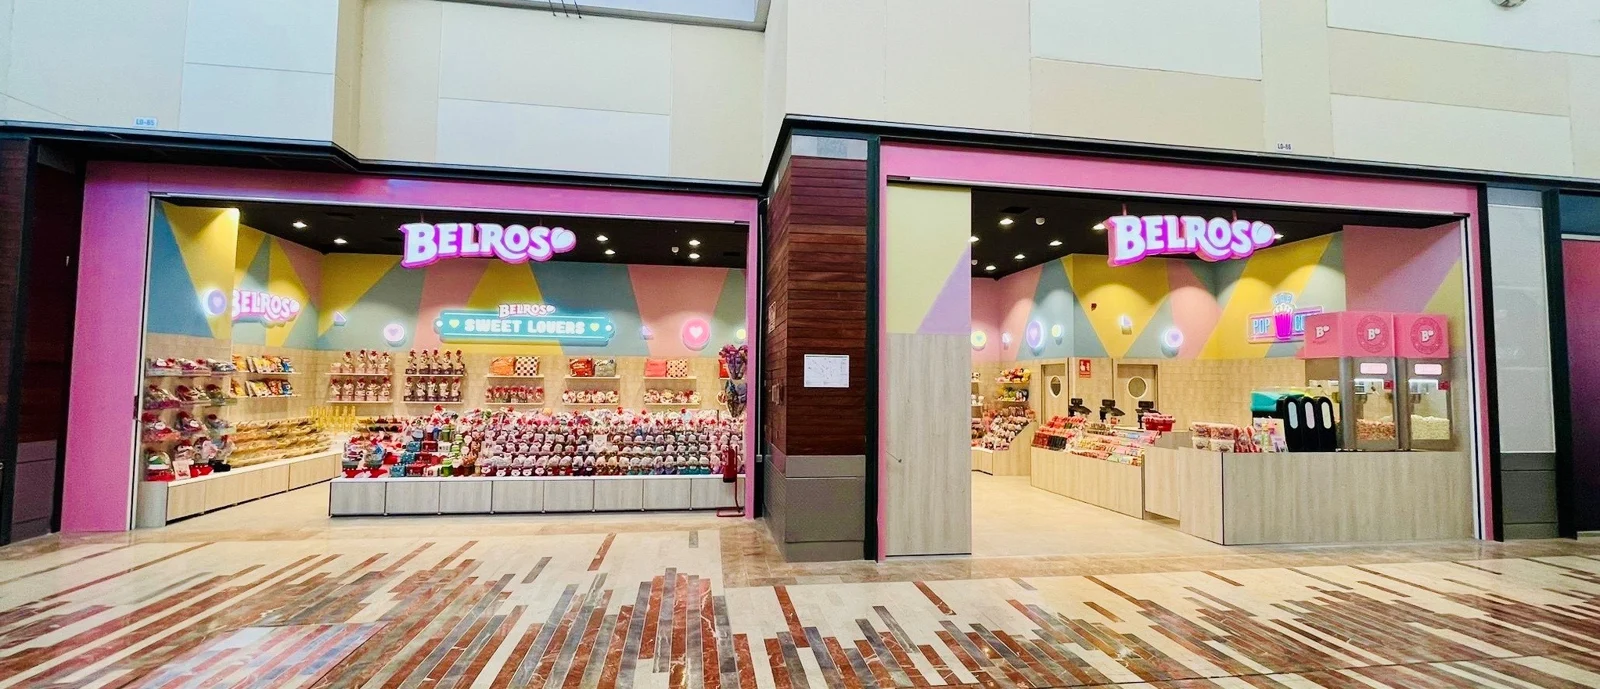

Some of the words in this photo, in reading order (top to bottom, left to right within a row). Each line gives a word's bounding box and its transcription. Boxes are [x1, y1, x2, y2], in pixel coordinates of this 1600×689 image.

[402, 223, 552, 268] BELROS
[1106, 215, 1254, 267] BELROS
[498, 304, 548, 318] BELROS
[464, 319, 522, 333] SWEET
[527, 320, 585, 335] LOVERS
[1253, 318, 1270, 335] POP
